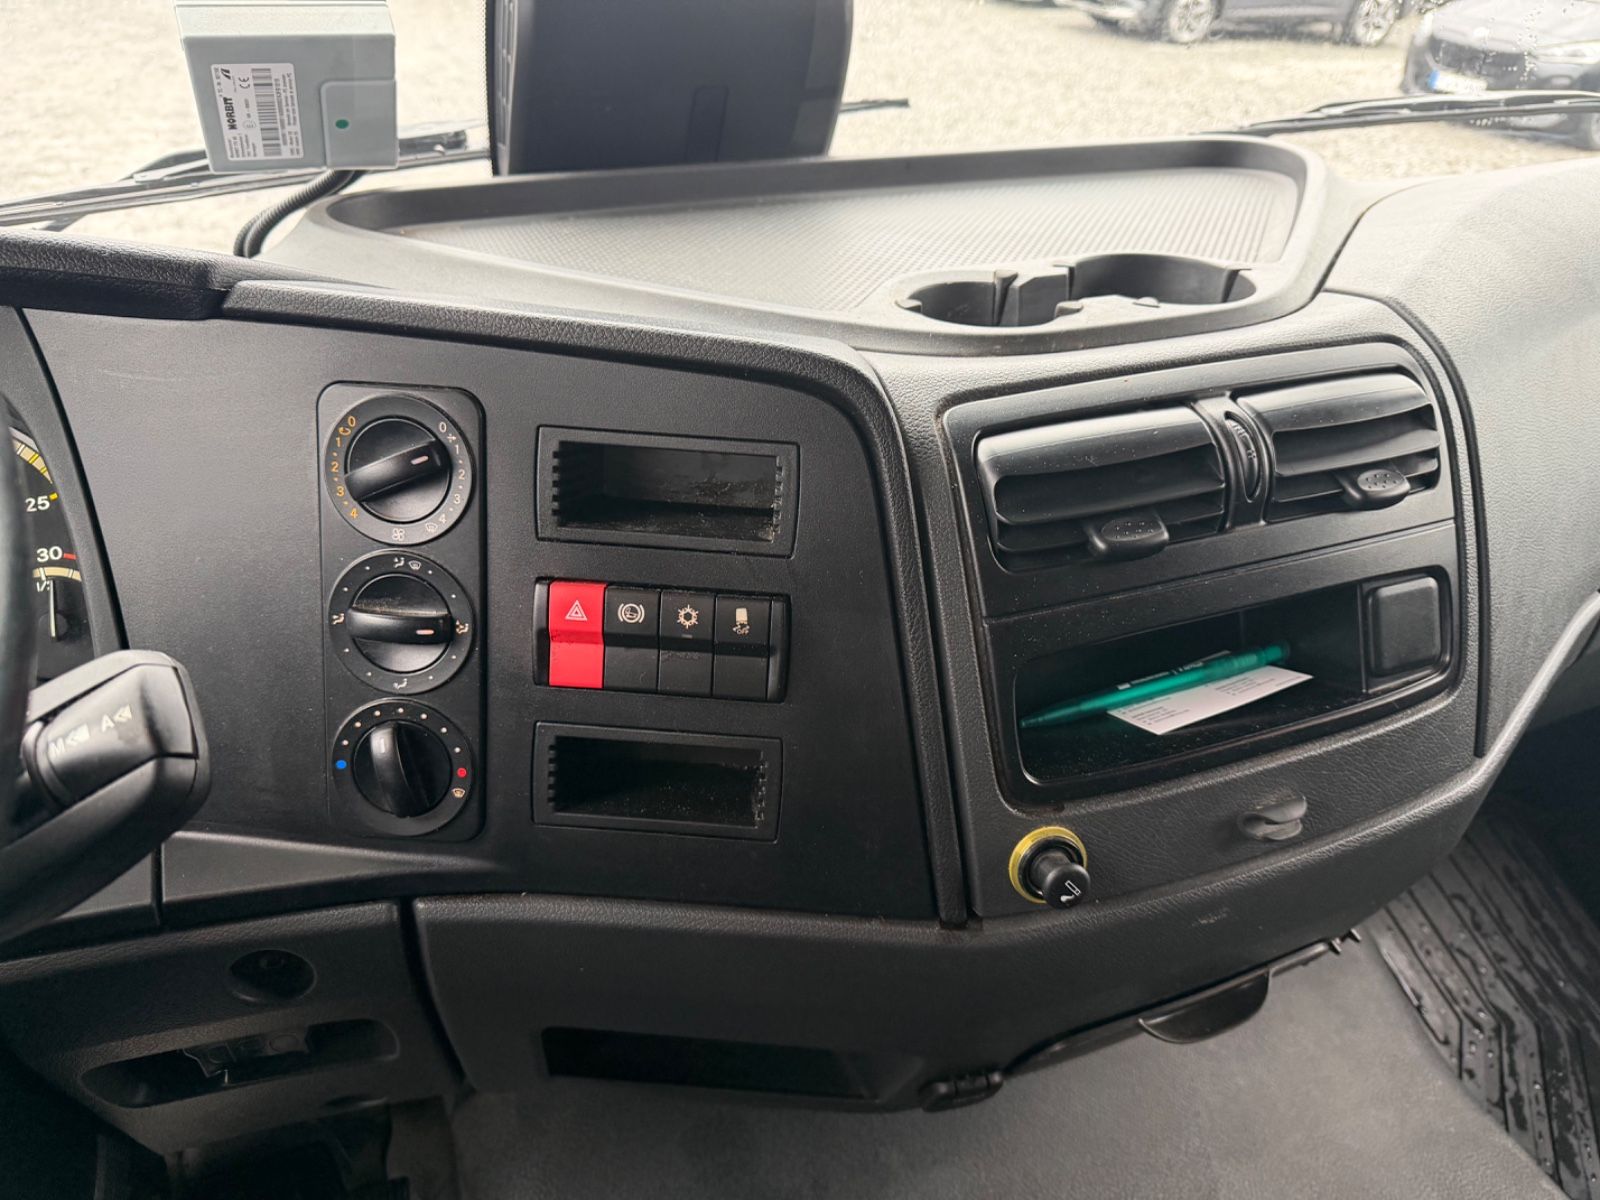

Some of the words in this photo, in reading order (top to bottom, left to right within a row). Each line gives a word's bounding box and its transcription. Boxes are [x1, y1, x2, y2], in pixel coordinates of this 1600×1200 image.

[222, 97, 238, 130] NORBIT
[347, 416, 356, 427] 0
[438, 422, 447, 433] 0
[335, 437, 341, 447] 1
[455, 444, 460, 454] 1
[331, 462, 339, 473] 2
[458, 469, 466, 480] 2
[336, 486, 345, 497] 3
[25, 495, 51, 513] 25
[454, 494, 461, 504] 3
[350, 508, 358, 519] 4
[438, 514, 446, 524] 4
[36, 545, 63, 563] 30
